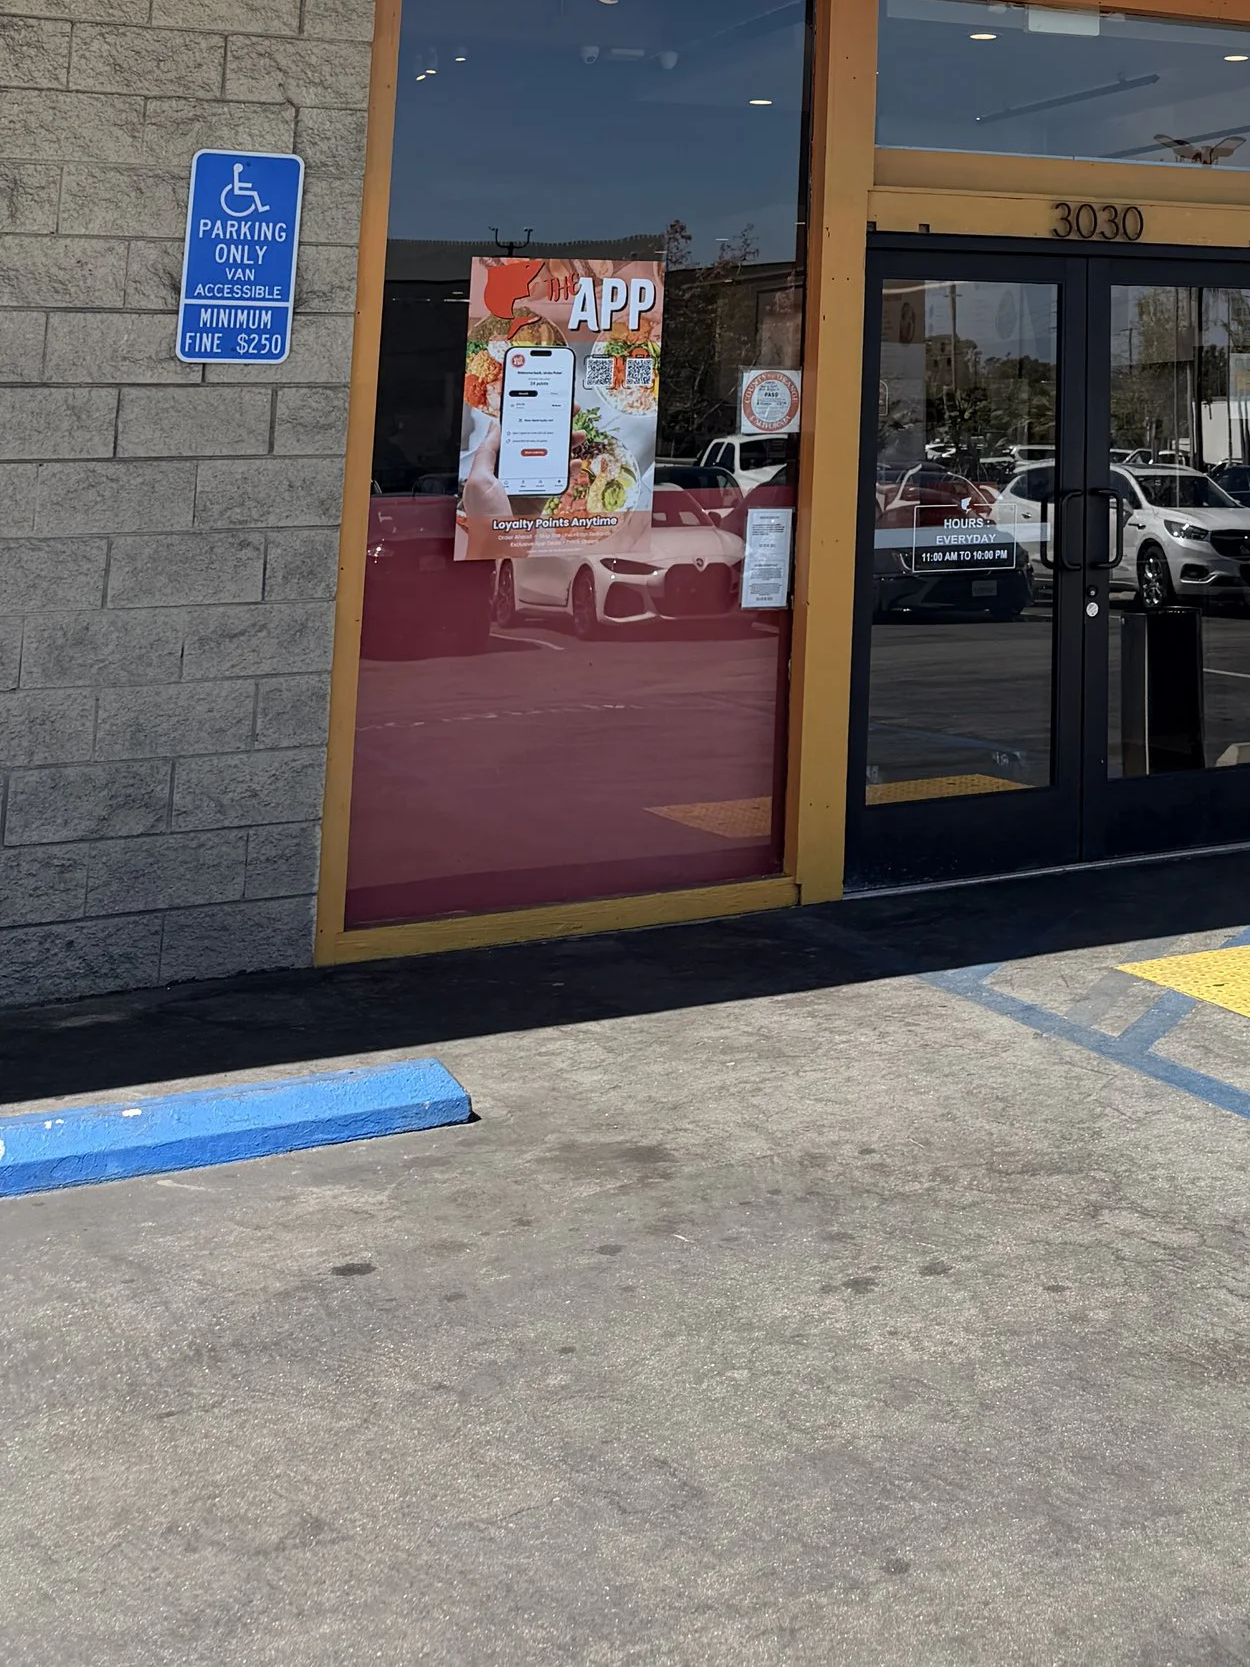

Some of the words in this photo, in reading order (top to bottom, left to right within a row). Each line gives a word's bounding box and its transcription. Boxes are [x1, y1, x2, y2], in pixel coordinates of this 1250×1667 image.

[198, 219, 287, 242] PARKING
[1053, 202, 1144, 241] 3030
[215, 243, 268, 265] ONLY
[225, 267, 255, 281] VAN
[194, 283, 282, 299] ACCESSIBLE
[567, 276, 657, 333] APP
[199, 307, 272, 329] MINIMUM
[184, 332, 223, 353] FINE
[236, 333, 282, 355] $250
[492, 518, 533, 534] Loyalty
[535, 517, 570, 530] Points
[571, 516, 618, 531] Anytime
[943, 518, 984, 529] HOURS
[936, 533, 997, 545] EVERYDAY
[921, 552, 943, 562] 11:00
[944, 551, 958, 561] AM
[959, 551, 971, 561] TO
[973, 550, 994, 560] 10:00
[995, 550, 1007, 559] PM
